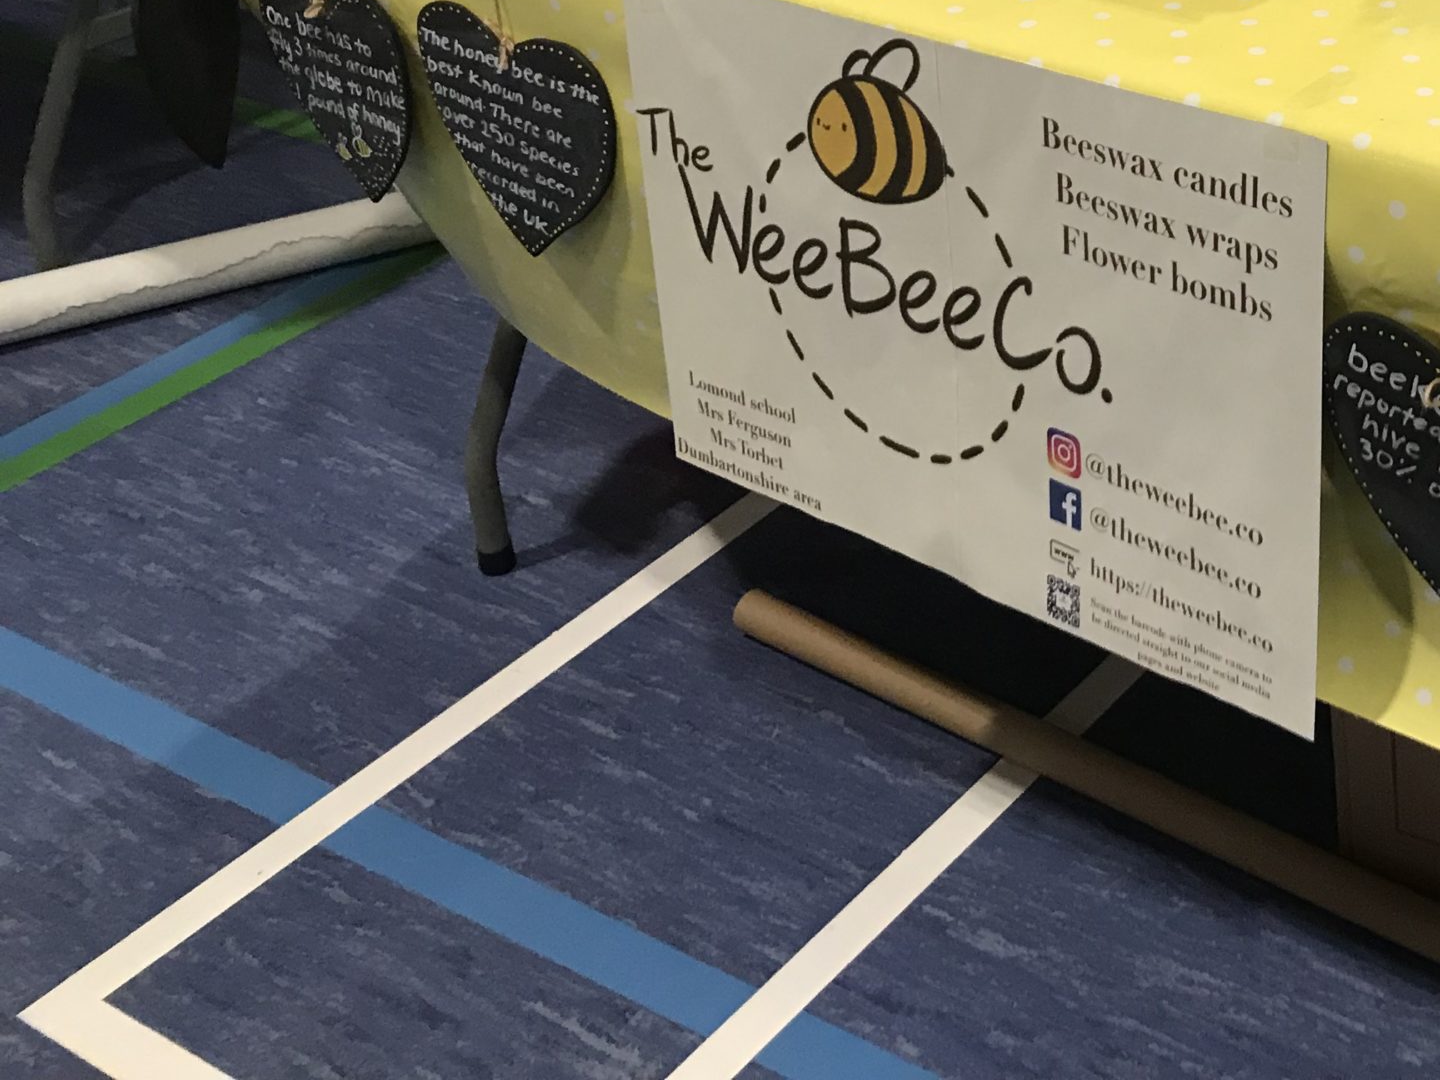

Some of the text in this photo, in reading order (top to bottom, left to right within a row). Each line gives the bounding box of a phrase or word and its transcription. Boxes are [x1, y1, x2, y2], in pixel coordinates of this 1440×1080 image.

[266, 5, 373, 58] One bee has to
[347, 80, 364, 97] to
[420, 26, 601, 106] The honey bee is the
[426, 56, 563, 119] best known bee
[347, 102, 361, 123] of
[442, 104, 580, 178] over 250 species
[490, 102, 540, 138] There
[546, 128, 573, 150] are
[636, 106, 714, 173] The
[453, 131, 576, 198] that have been
[471, 160, 561, 215] recorded in
[1042, 116, 1294, 218] Beeswax candles
[488, 191, 518, 218] the
[1056, 172, 1279, 274] Beeswax wraps
[1061, 224, 1273, 322] Flower bombs
[689, 370, 796, 424] Lomond school
[698, 398, 792, 448] Mrs Ferguson
[710, 427, 783, 470] Mrs Torbet
[1359, 437, 1418, 485] 30%
[1361, 412, 1421, 460] hive
[678, 436, 822, 511] Dumbartonshire area
[1085, 452, 1264, 547] @theweebee.co
[1090, 506, 1262, 600] @theweebee.co
